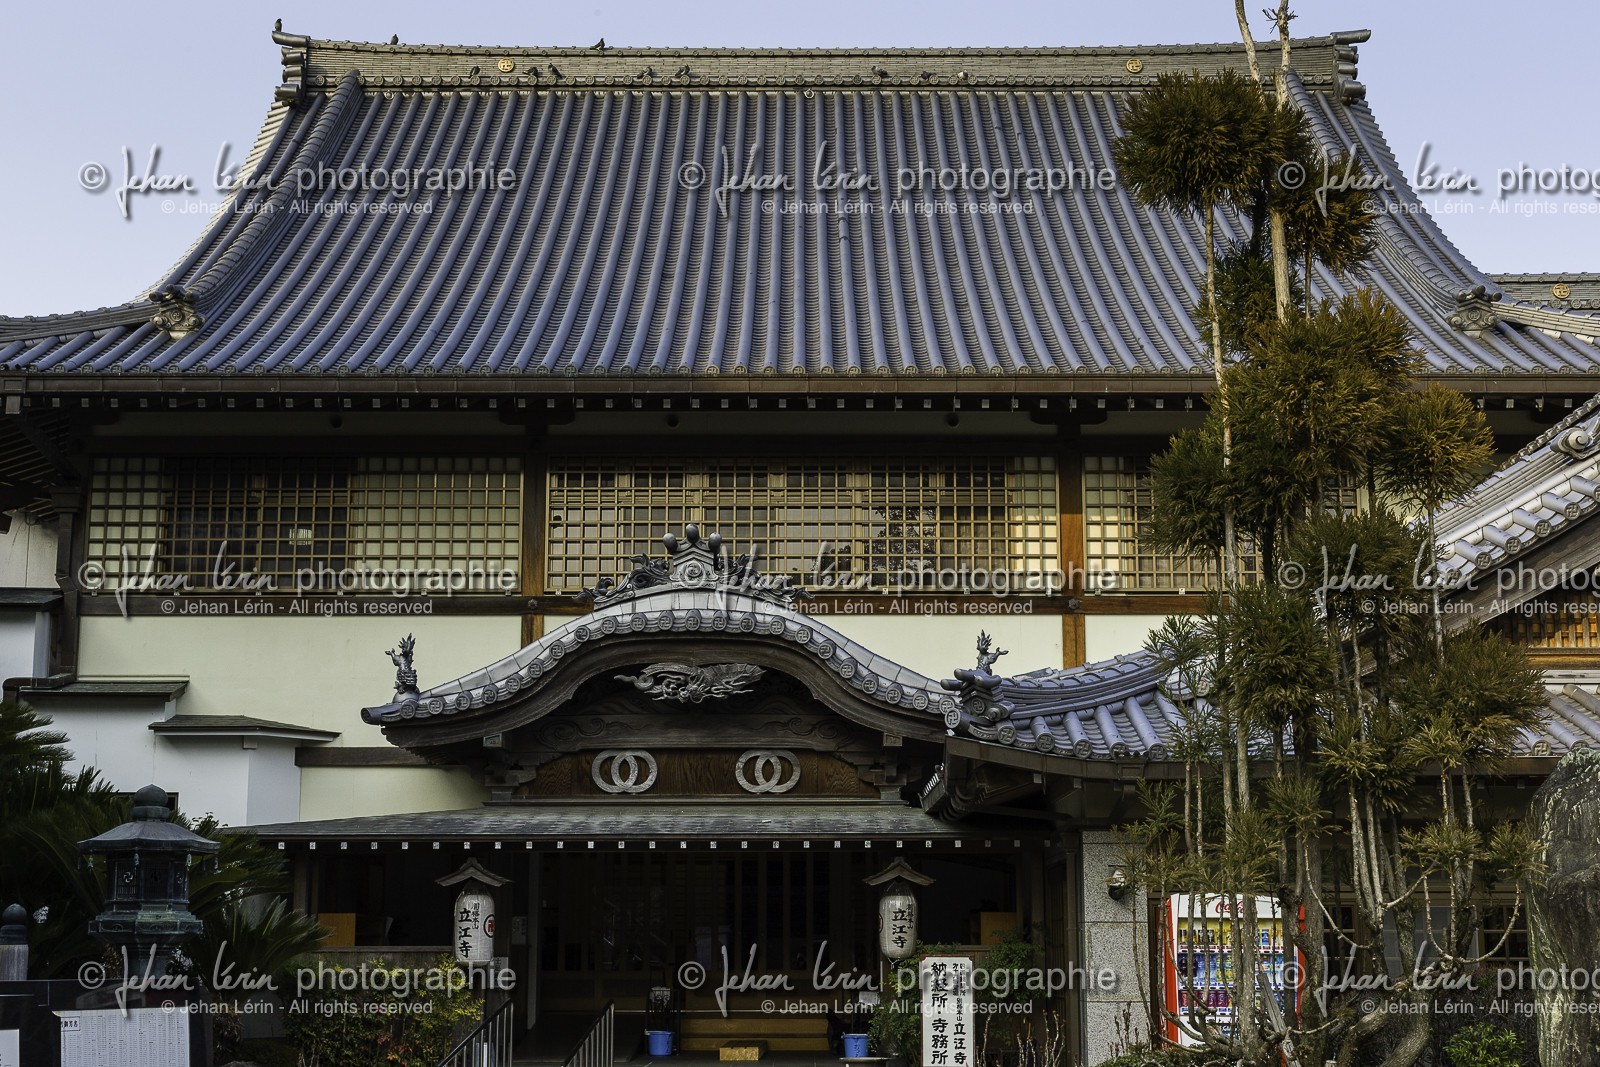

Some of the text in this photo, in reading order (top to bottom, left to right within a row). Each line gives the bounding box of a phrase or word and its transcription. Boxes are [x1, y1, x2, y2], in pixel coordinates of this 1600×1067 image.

[458, 908, 473, 958] 立江寺
[892, 908, 908, 948] 立江寺
[931, 962, 949, 1065] 納経所・寺務所
[953, 1023, 967, 1064] 立江寺
